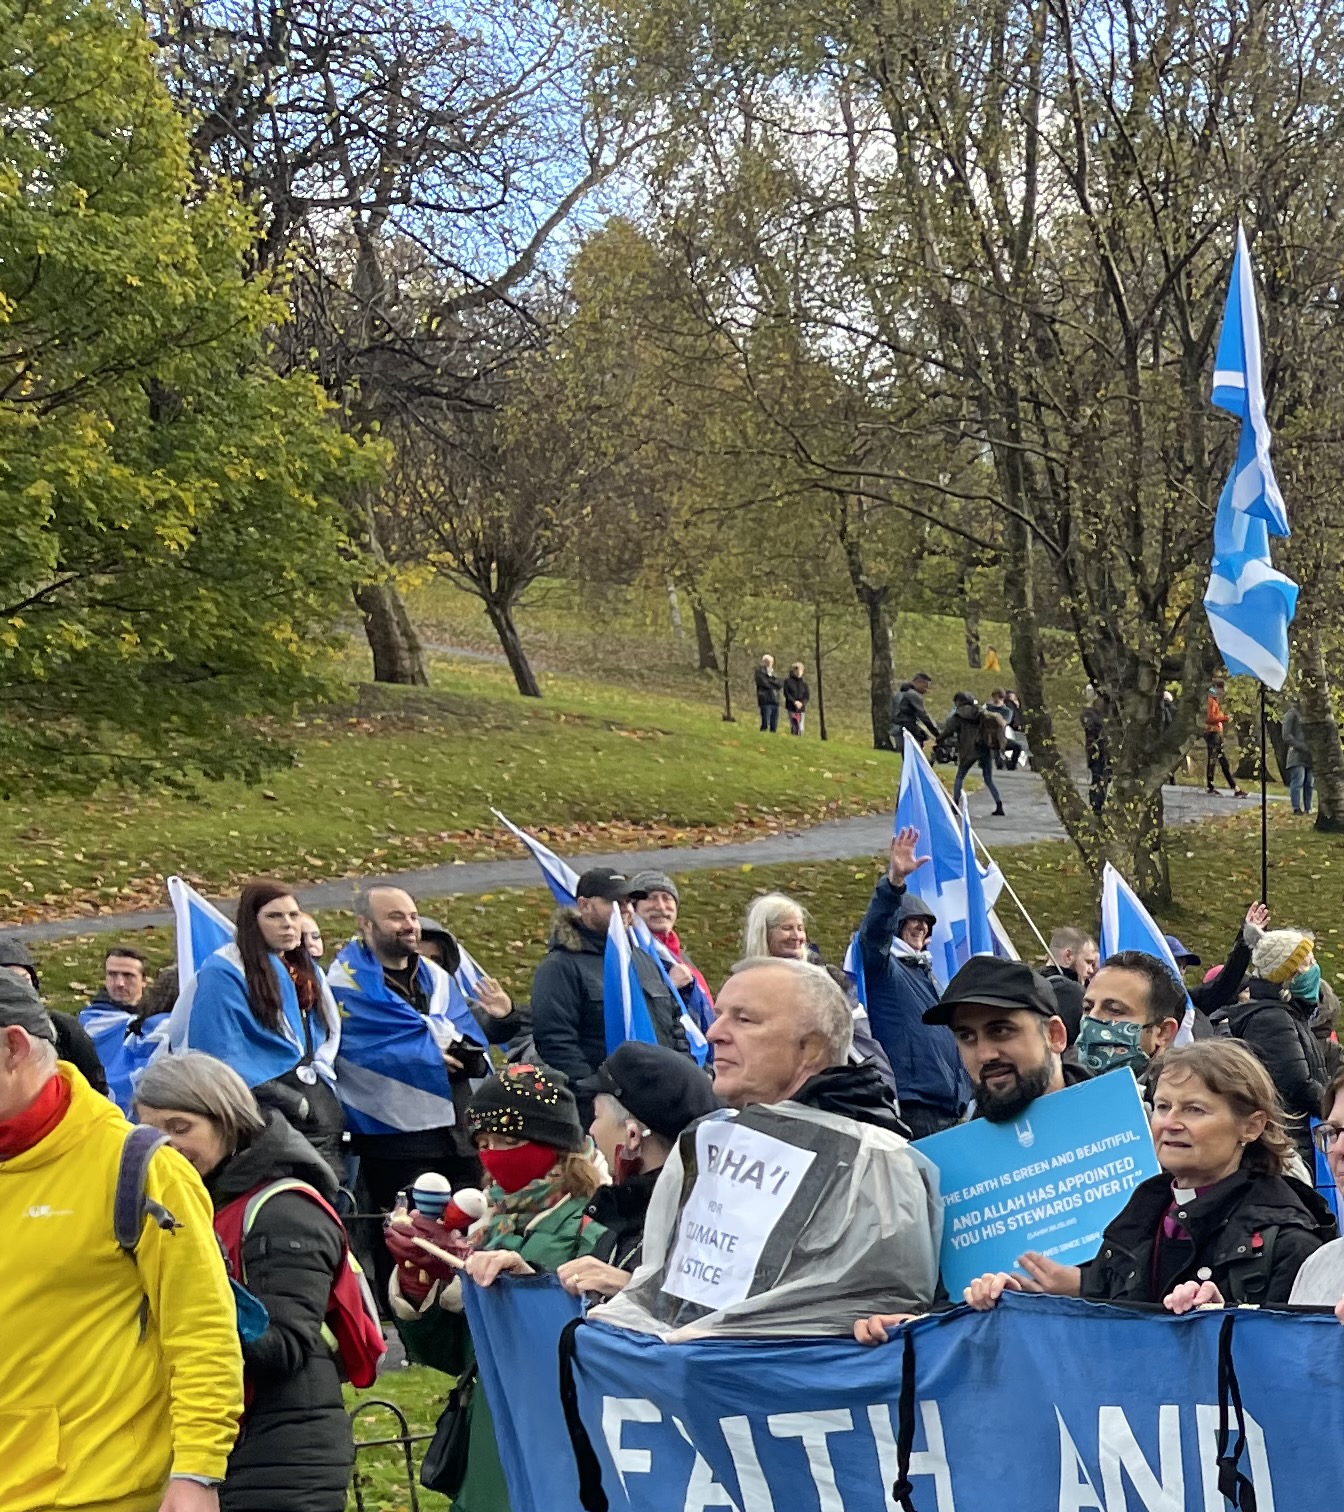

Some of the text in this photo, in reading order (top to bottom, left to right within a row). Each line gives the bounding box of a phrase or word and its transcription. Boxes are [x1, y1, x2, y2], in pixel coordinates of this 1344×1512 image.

[953, 1156, 1134, 1231] AND ALLAH HAS APPOINTED
[963, 1177, 998, 1200] EARTH
[999, 1171, 1012, 1186] IS
[1013, 1160, 1050, 1180] GREEN
[1051, 1151, 1074, 1168] AND
[951, 1230, 980, 1250] YOU
[982, 1219, 1006, 1240] HIS
[1007, 1193, 1082, 1231] STEWARDS
[1084, 1181, 1121, 1202] OVER
